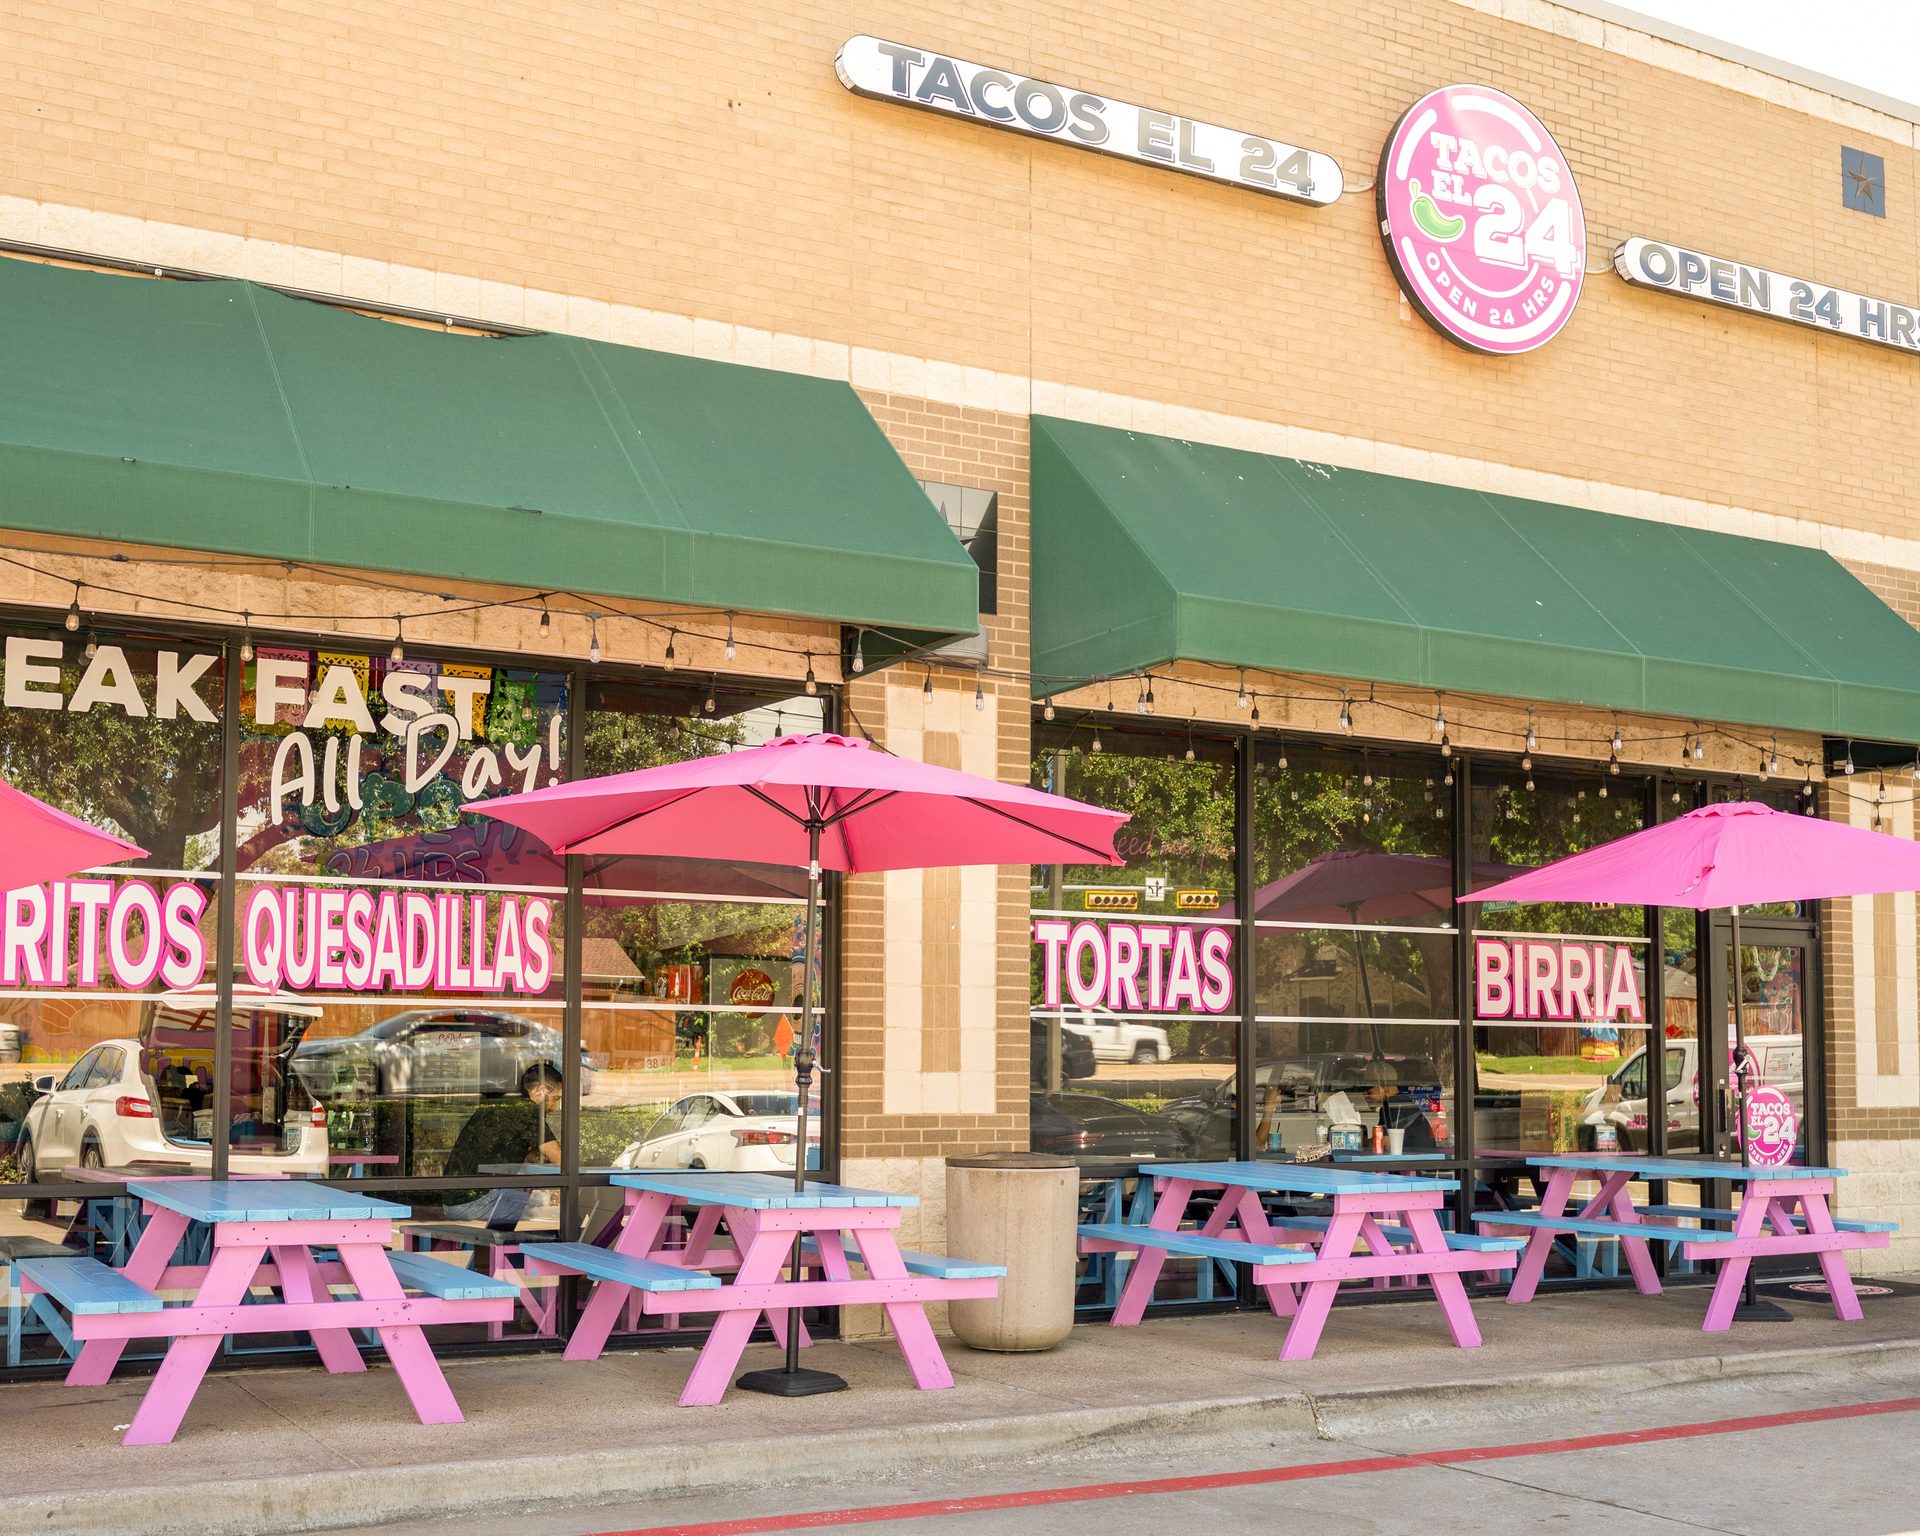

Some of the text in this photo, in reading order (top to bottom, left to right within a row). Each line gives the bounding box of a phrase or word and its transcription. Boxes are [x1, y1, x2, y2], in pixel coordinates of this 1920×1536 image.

[878, 44, 1314, 195] TACOS EL 24
[1430, 131, 1561, 193] TACOS
[1432, 170, 1581, 280] EL 24
[1426, 252, 1554, 325] OPEN 24 HRS
[1639, 243, 1920, 348] OPEN 24 HR
[256, 658, 491, 740] FAST
[271, 713, 562, 826] All Day!
[244, 886, 553, 996] QUESADILLAS
[1035, 920, 1233, 1014] TORTAS
[1476, 939, 1643, 1020] BIRRIA
[732, 985, 771, 1001] Coca-Cola
[1750, 1102, 1791, 1116] TACOS
[1750, 1115, 1796, 1144] EL 24
[1748, 1144, 1765, 1164] OPEN
